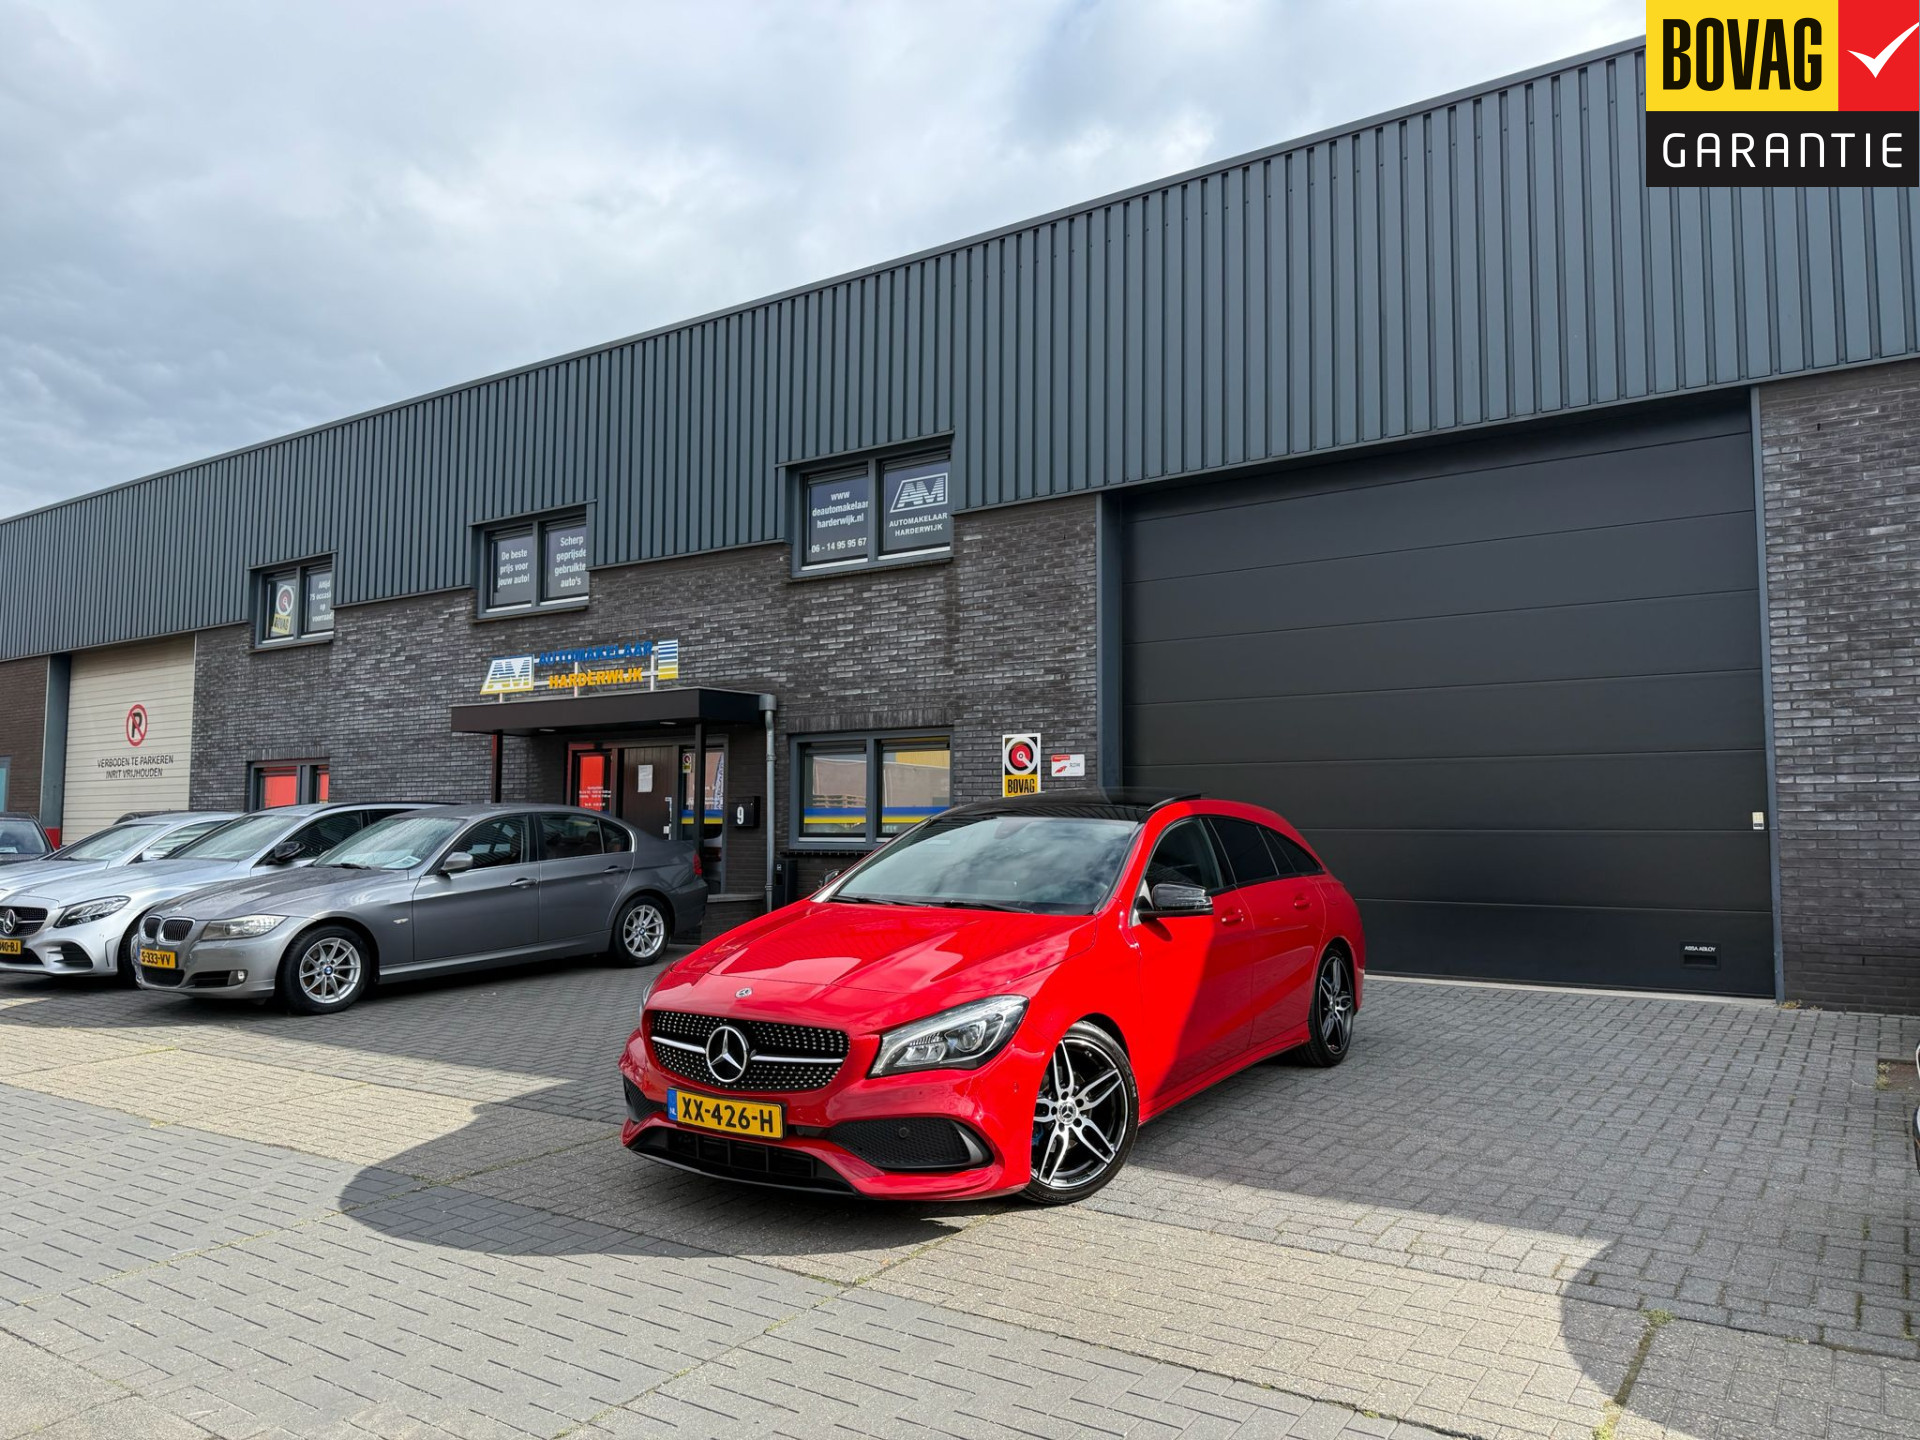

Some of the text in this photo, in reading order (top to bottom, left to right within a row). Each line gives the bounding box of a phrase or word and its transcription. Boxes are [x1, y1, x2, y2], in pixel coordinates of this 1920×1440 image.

[831, 491, 850, 501] www
[812, 501, 868, 517] deautomakelaar
[817, 513, 864, 528] harderwijk.nl
[889, 512, 948, 528] AUTOMAKELAAR
[895, 524, 943, 536] HARDERWIJK
[560, 536, 584, 546] Scherp
[811, 544, 820, 553] 06
[827, 542, 835, 551] 14
[837, 540, 846, 549] 95
[848, 539, 856, 548] 95
[858, 537, 867, 546] 67
[501, 549, 528, 560] De beste
[556, 548, 586, 562] geprijsde
[500, 563, 528, 575] prijs voor
[555, 562, 586, 576] gebruikte
[498, 574, 530, 588] jouw auto!
[561, 577, 581, 588] auto's
[538, 641, 653, 666] AUTOMAKELAAR
[549, 668, 643, 689] HARDERWIJK
[97, 755, 174, 768] VERBODEN TE PARKEREN
[106, 767, 163, 779] INRIT VRIJHOUDEN
[1008, 778, 1035, 794] BOVAG
[737, 806, 744, 824] 9
[141, 950, 171, 965] S-333-VV
[682, 1096, 773, 1133] XX-426-H
